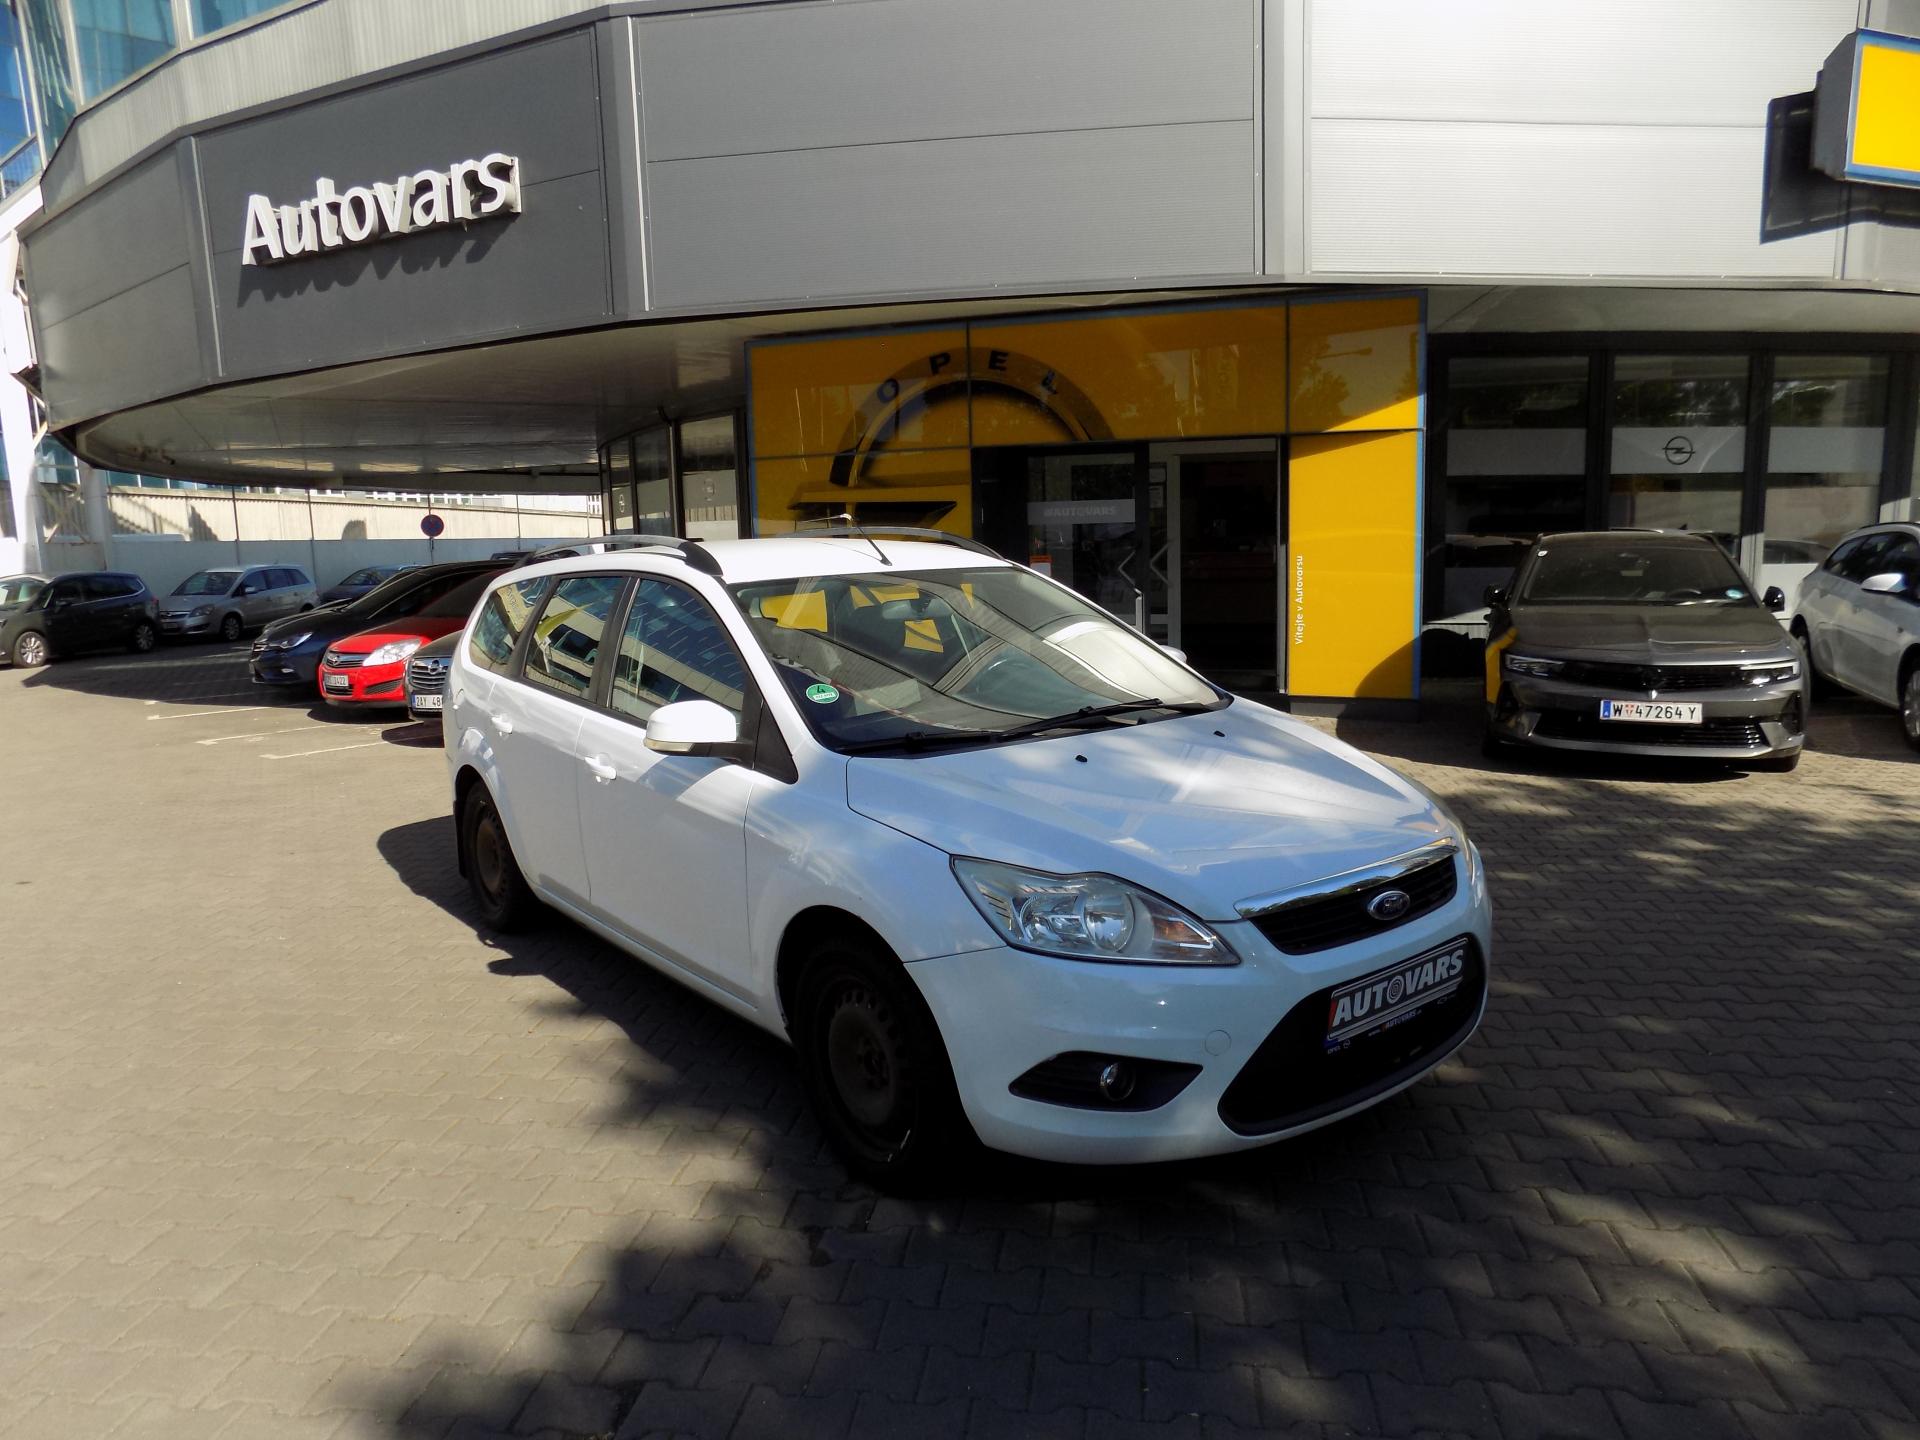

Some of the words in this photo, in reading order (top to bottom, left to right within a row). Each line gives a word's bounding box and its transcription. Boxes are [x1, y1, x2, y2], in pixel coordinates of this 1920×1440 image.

[242, 152, 519, 265] Autovars
[877, 350, 1058, 404] OPEL
[1295, 555, 1304, 603] Autovarsu
[416, 696, 427, 706] 2AY
[1613, 703, 1623, 717] W
[1635, 704, 1682, 719] 47264
[1688, 706, 1697, 719] Y
[1332, 949, 1464, 1028] AUTOVARS
